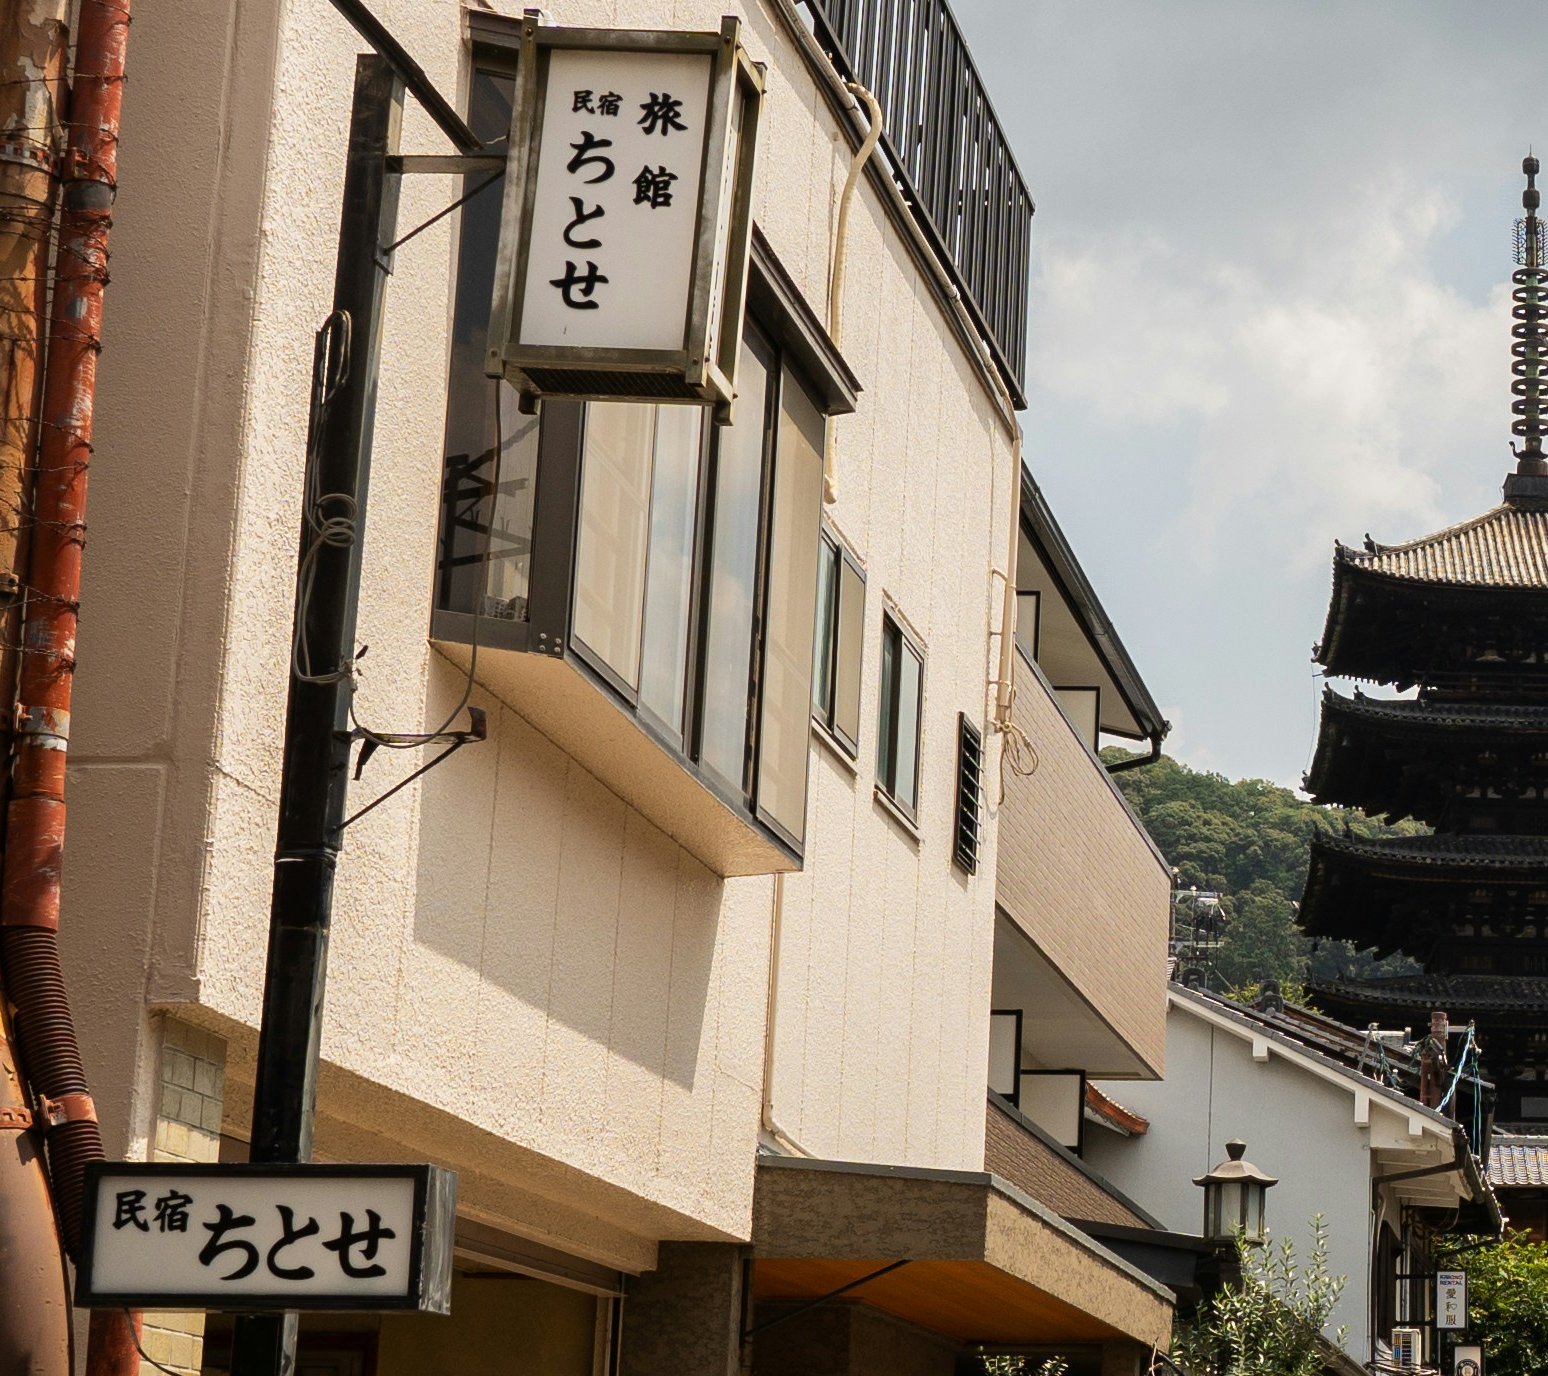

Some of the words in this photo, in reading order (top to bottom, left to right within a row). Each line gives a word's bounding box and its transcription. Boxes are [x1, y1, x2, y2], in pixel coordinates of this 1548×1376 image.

[570, 87, 624, 120] 民宿
[633, 90, 689, 212] 旅館
[549, 131, 618, 313] ちとせ
[113, 1187, 191, 1235] 民宿
[198, 1202, 397, 1284] ちとせ
[1445, 1288, 1458, 1326] 愛和服
